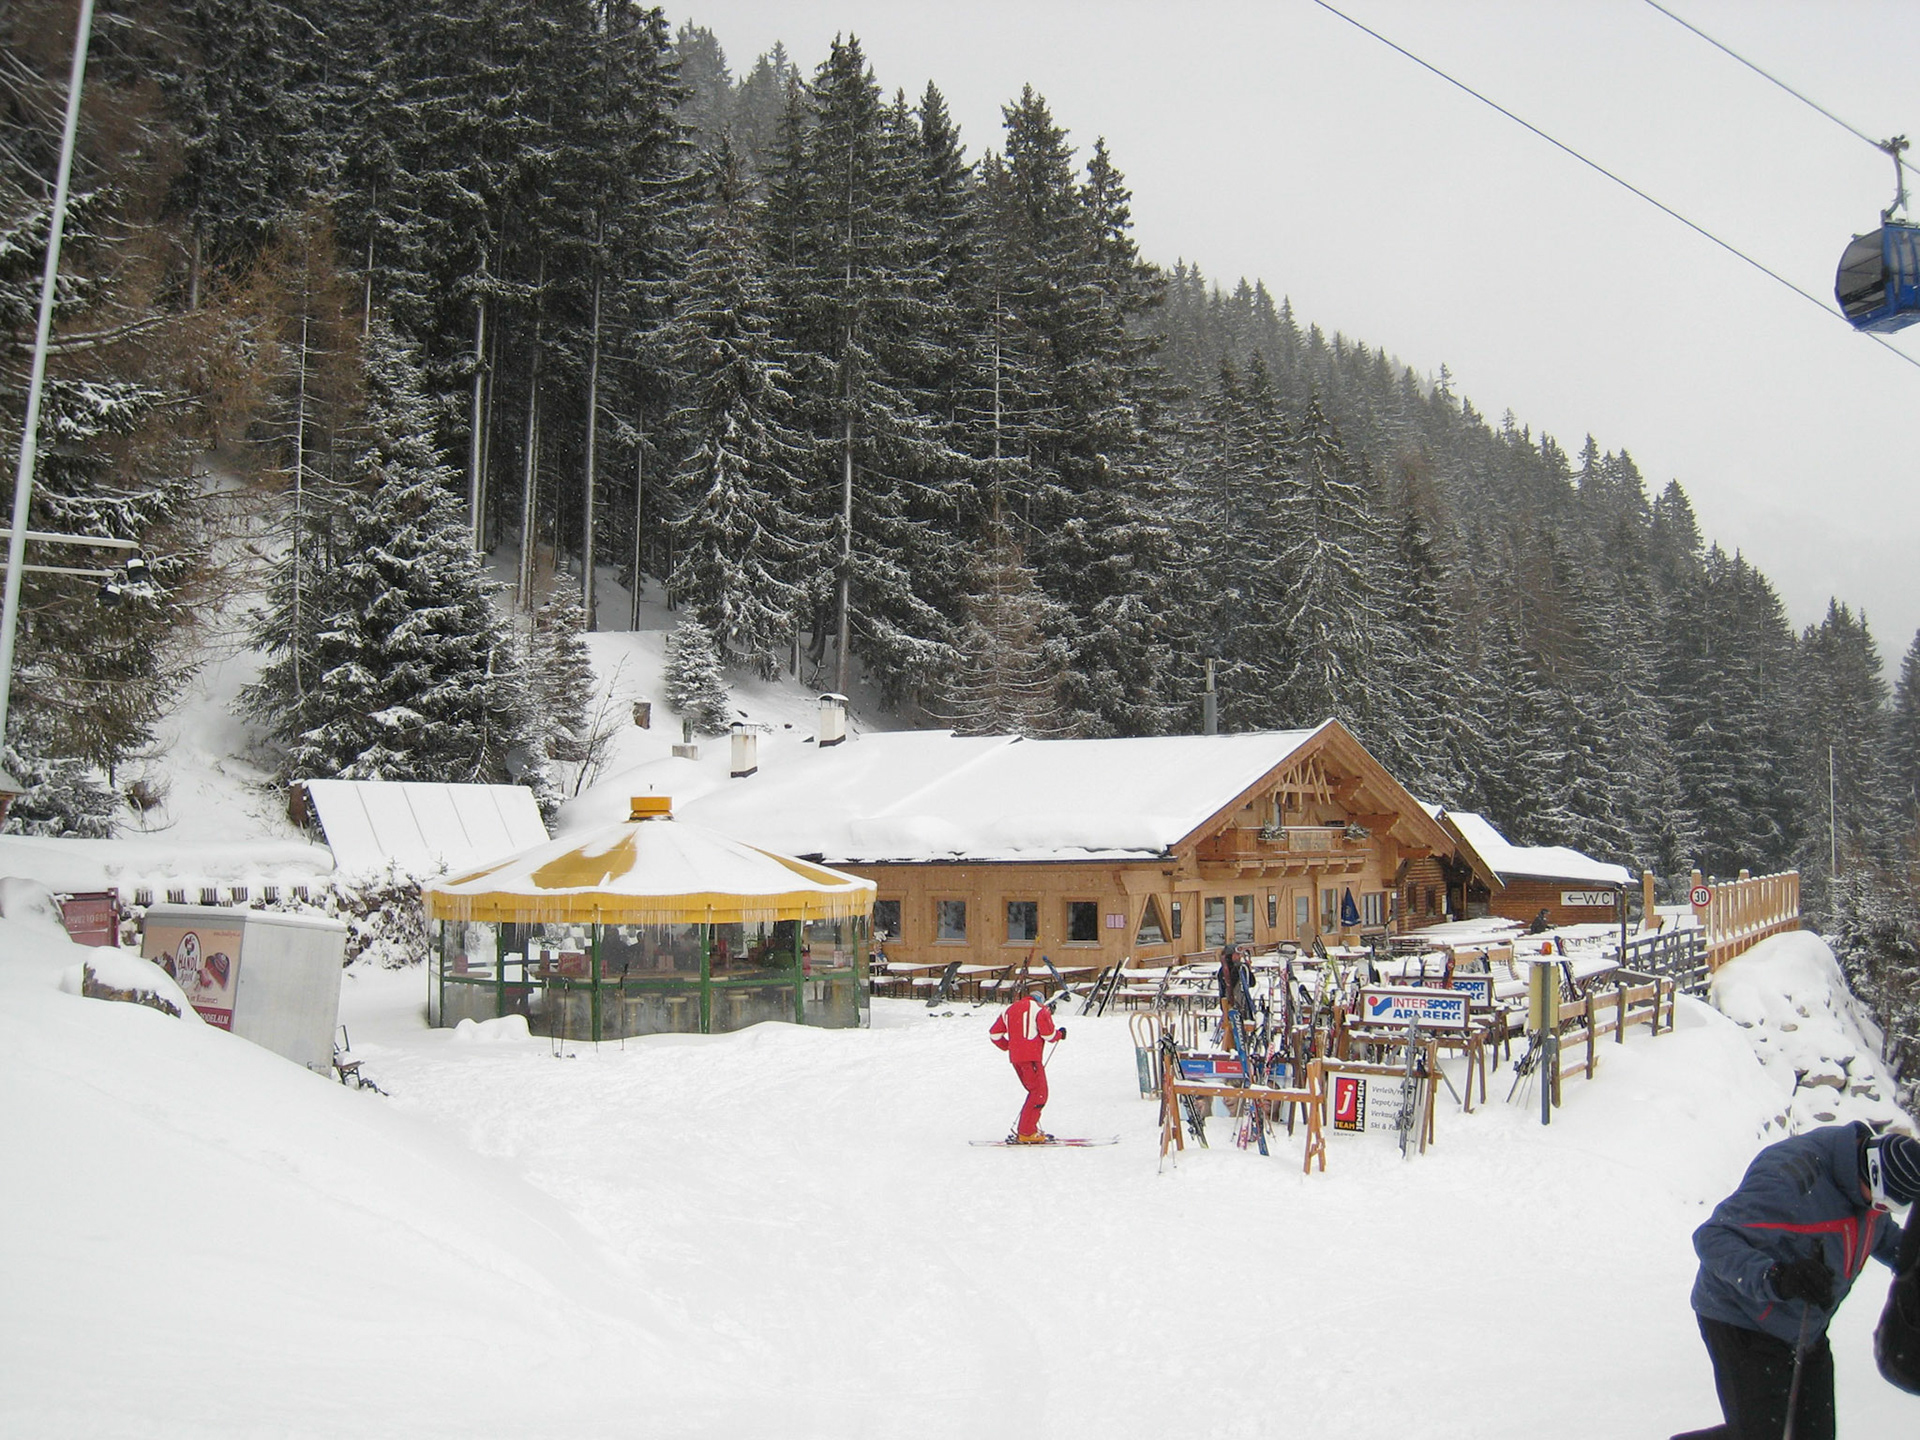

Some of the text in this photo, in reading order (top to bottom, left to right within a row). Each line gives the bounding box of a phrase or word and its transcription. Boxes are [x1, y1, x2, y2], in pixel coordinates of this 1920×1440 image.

[1583, 892, 1610, 905] WC
[1695, 891, 1707, 902] 30
[1423, 981, 1485, 992] INTESPORT
[1393, 997, 1462, 1011] INTERSPORT
[1356, 1079, 1365, 1131] JENNEWEIN
[1335, 1121, 1355, 1130] TEAM
